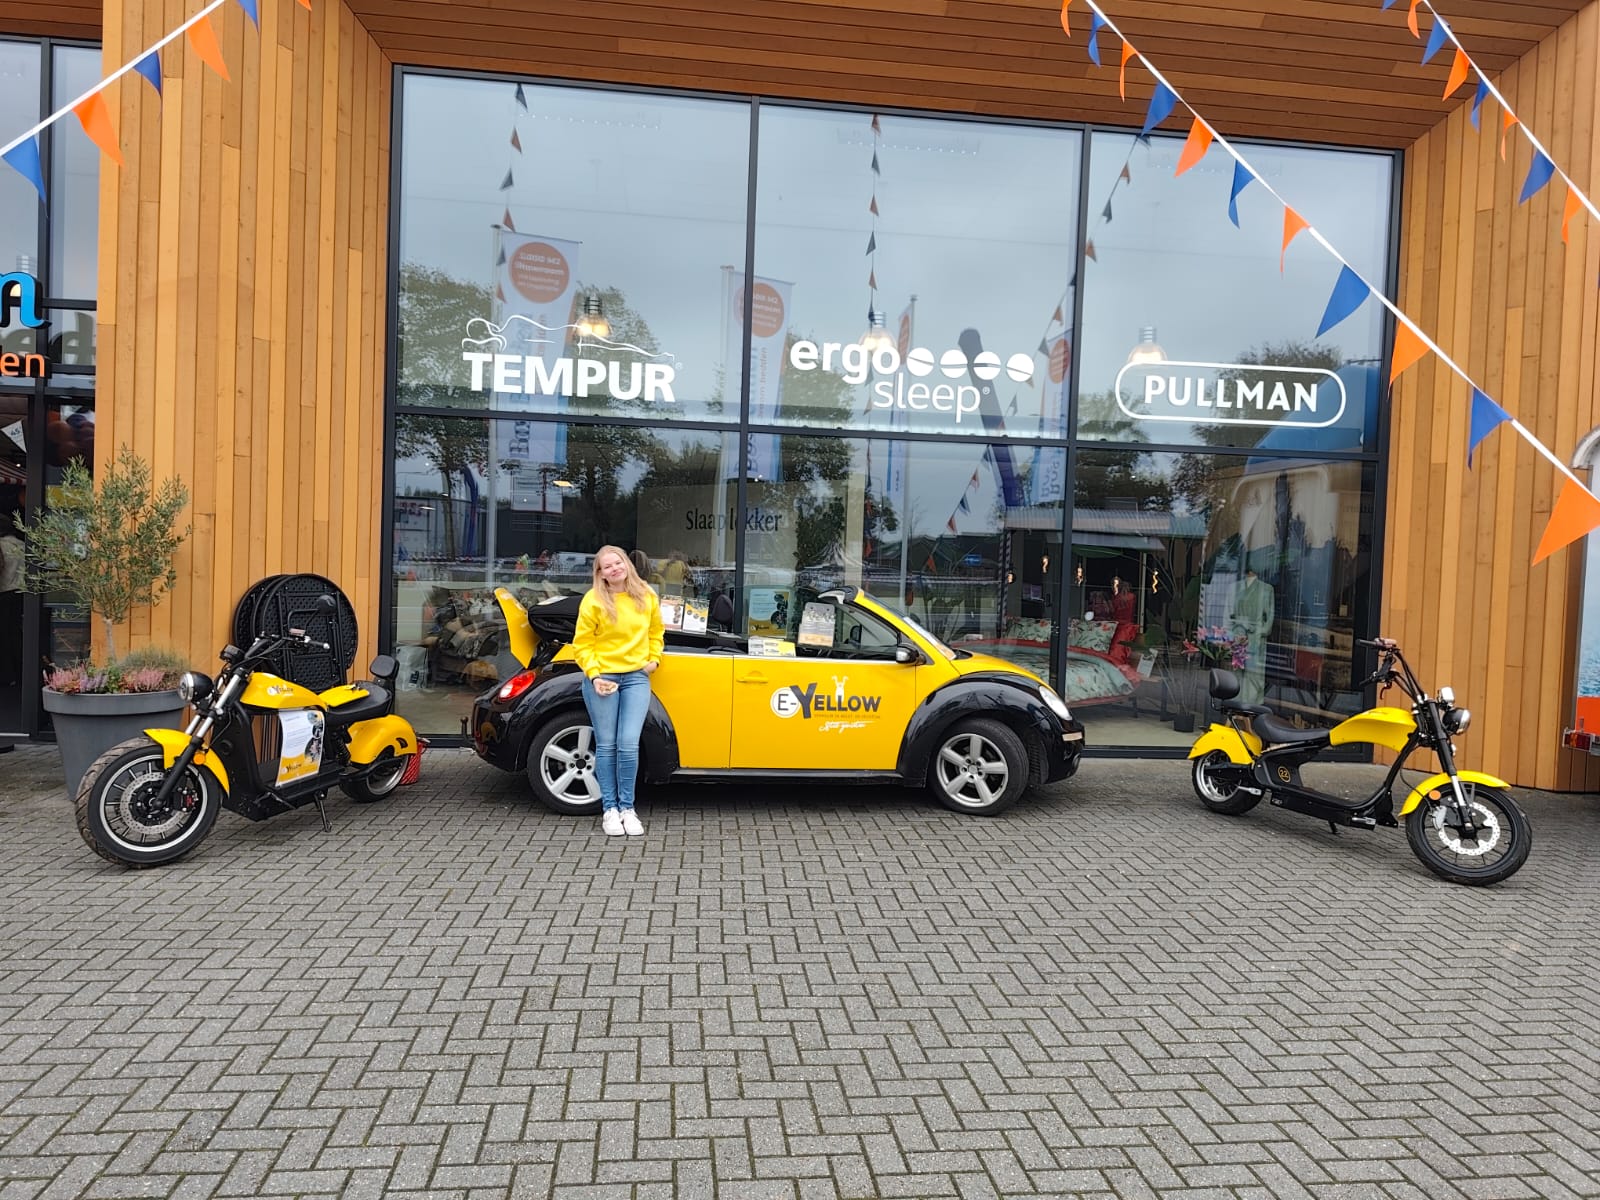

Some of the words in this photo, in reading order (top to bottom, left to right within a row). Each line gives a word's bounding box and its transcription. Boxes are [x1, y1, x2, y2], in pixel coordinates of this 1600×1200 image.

[462, 351, 676, 403] TEMPUR
[789, 339, 901, 385] ergo
[1144, 375, 1319, 413] PULLMAN
[729, 507, 783, 532] lkker
